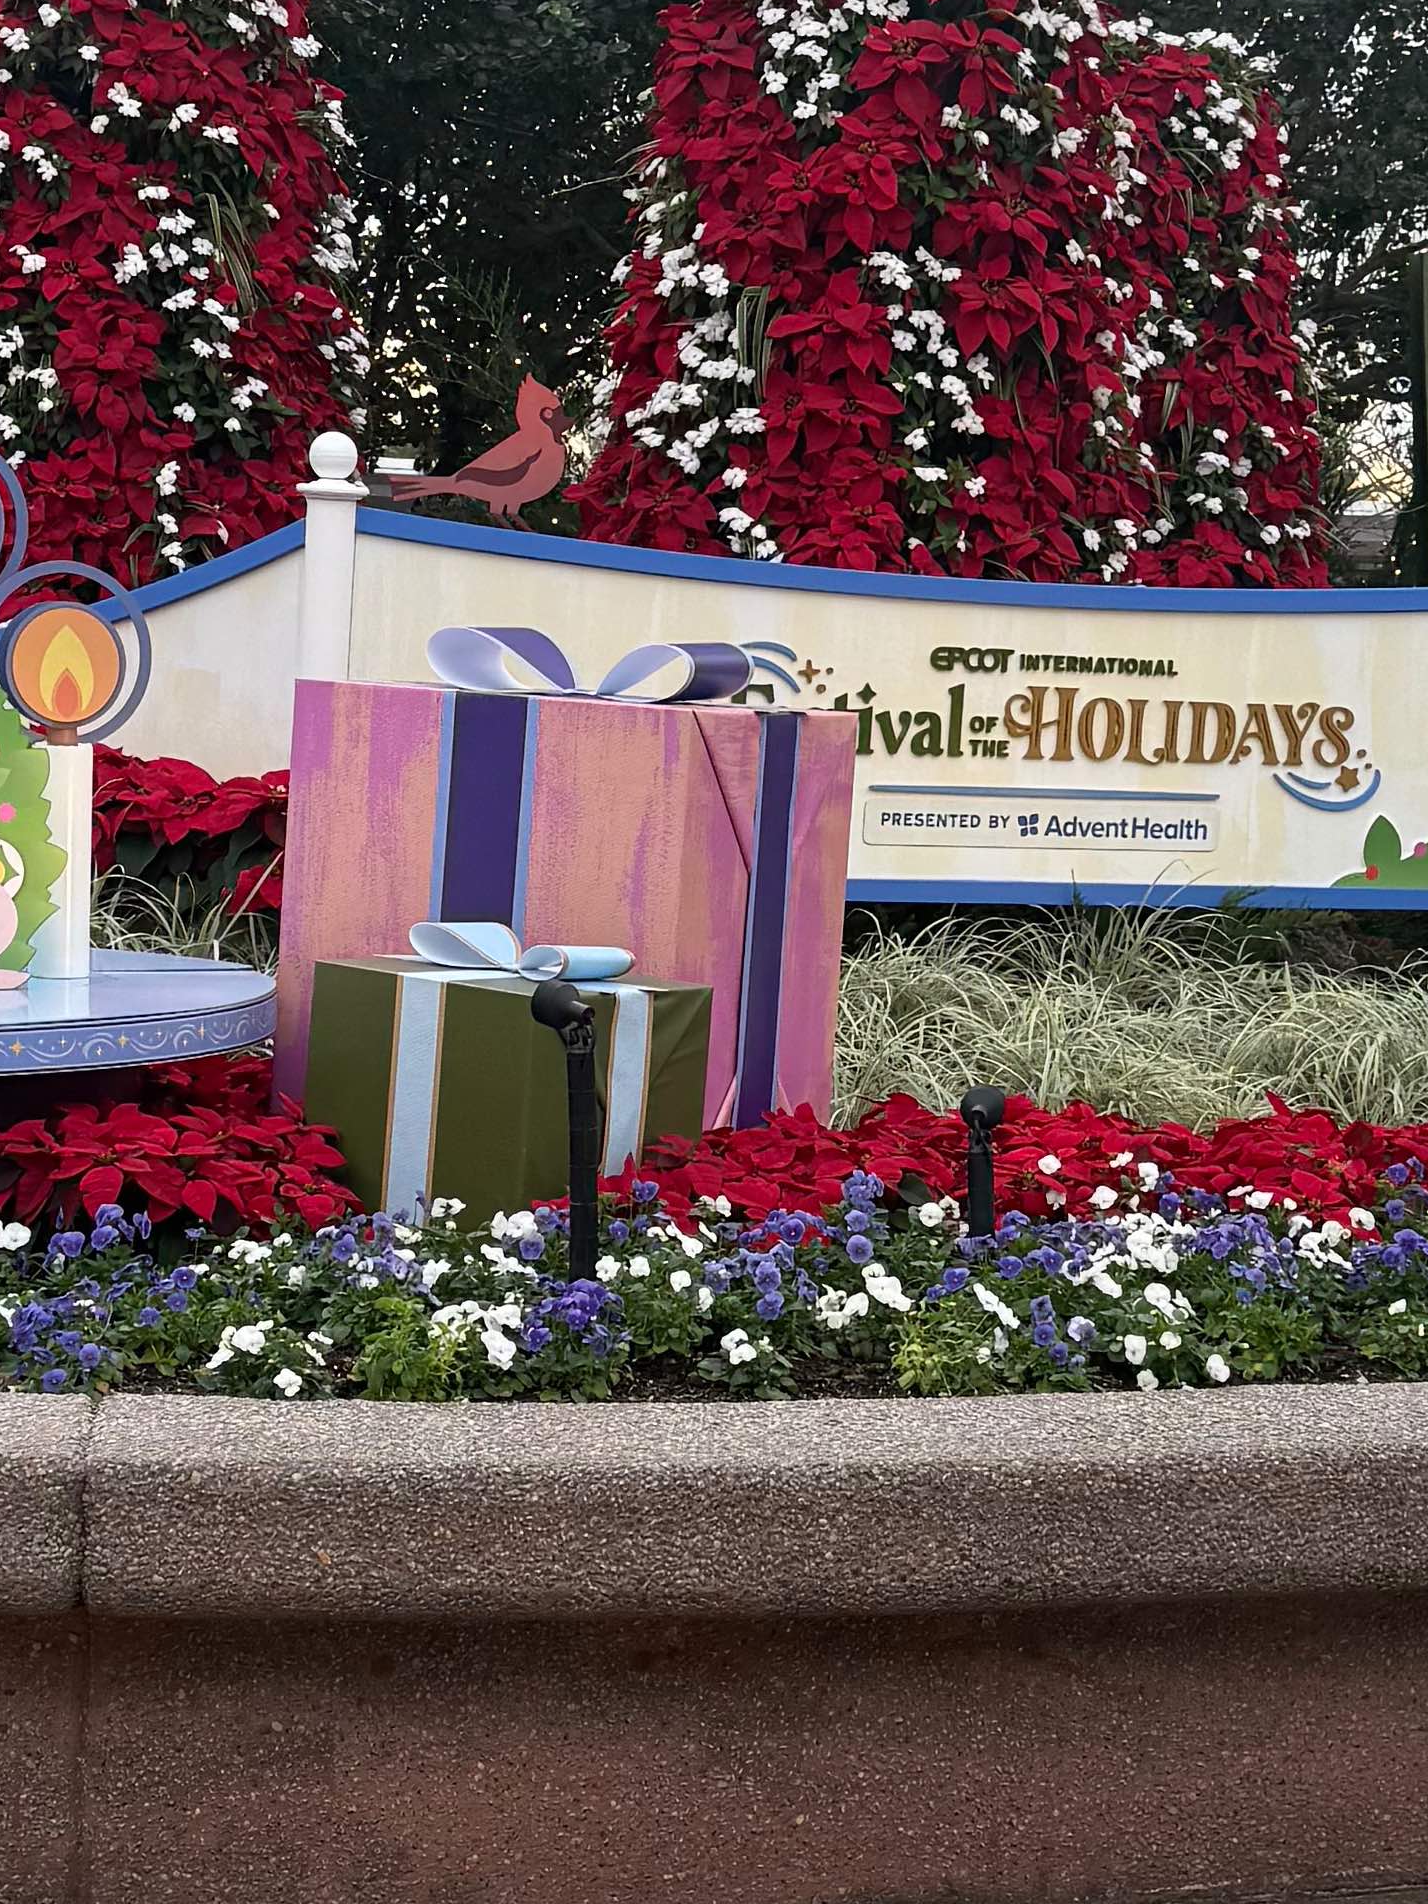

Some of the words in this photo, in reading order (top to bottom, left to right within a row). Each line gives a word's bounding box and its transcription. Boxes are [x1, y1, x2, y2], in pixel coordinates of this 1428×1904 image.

[930, 646, 1015, 674] EPCOT
[1019, 653, 1178, 678] INTERNATIONAL
[969, 715, 1000, 734] OF
[1003, 685, 1355, 768] HOLIDAYS
[969, 739, 1010, 758] THE
[880, 811, 981, 829] PRESENTED
[988, 814, 1011, 829] BY
[1044, 815, 1208, 841] AdventHealth
